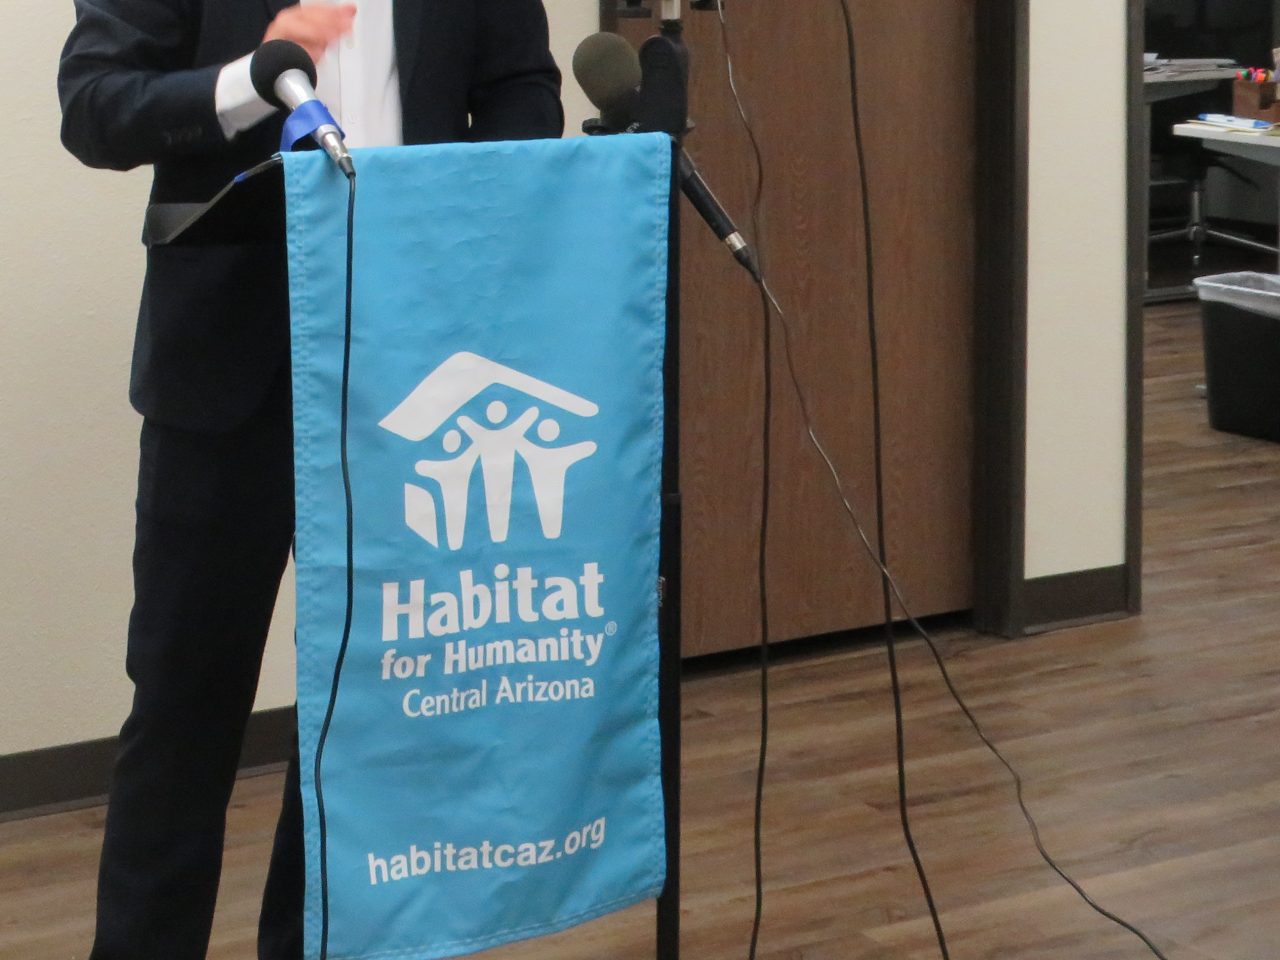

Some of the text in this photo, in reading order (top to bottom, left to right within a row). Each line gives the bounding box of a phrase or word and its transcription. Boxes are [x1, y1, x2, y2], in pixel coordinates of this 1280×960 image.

[381, 561, 605, 642] Habitat
[380, 648, 432, 681] for
[402, 675, 595, 719] Central Arizona
[366, 816, 607, 886] habitatcaz.org
